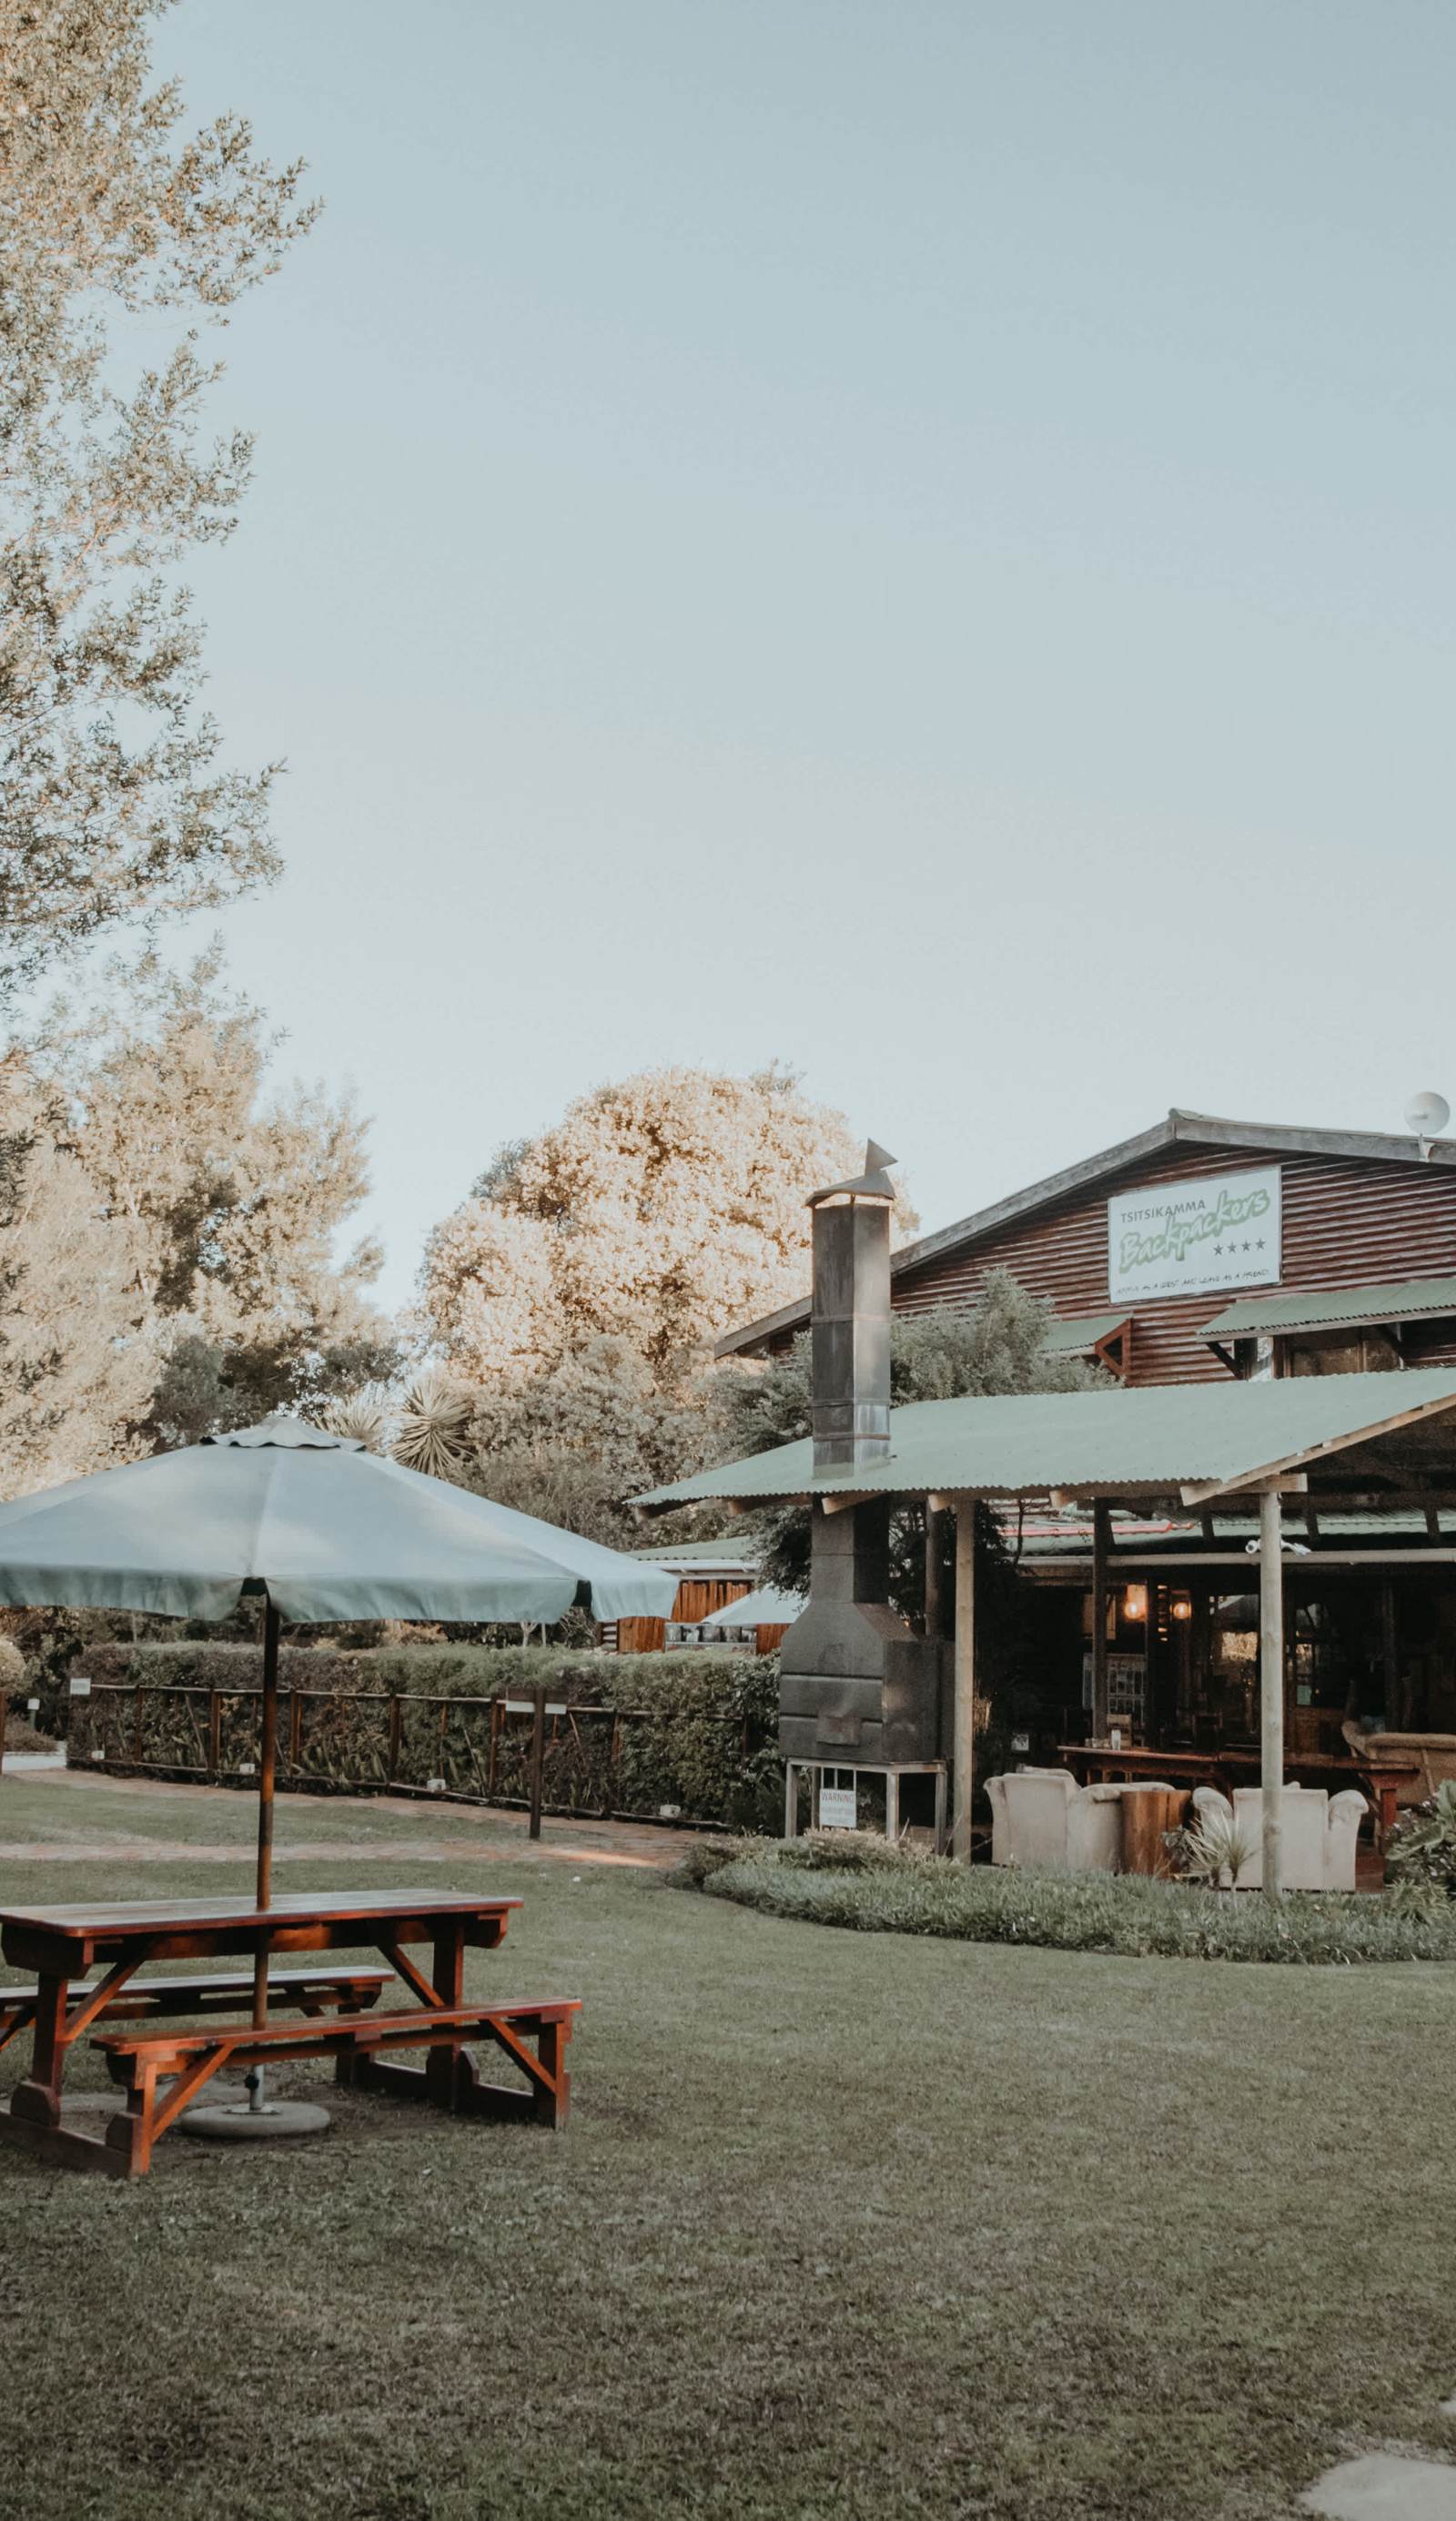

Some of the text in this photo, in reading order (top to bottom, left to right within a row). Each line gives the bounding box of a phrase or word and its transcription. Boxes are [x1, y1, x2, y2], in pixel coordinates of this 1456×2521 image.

[1121, 1200, 1206, 1223] TSITSIKAMMA
[1119, 1189, 1270, 1274] Backpackers
[822, 1791, 854, 1803] WARNING
